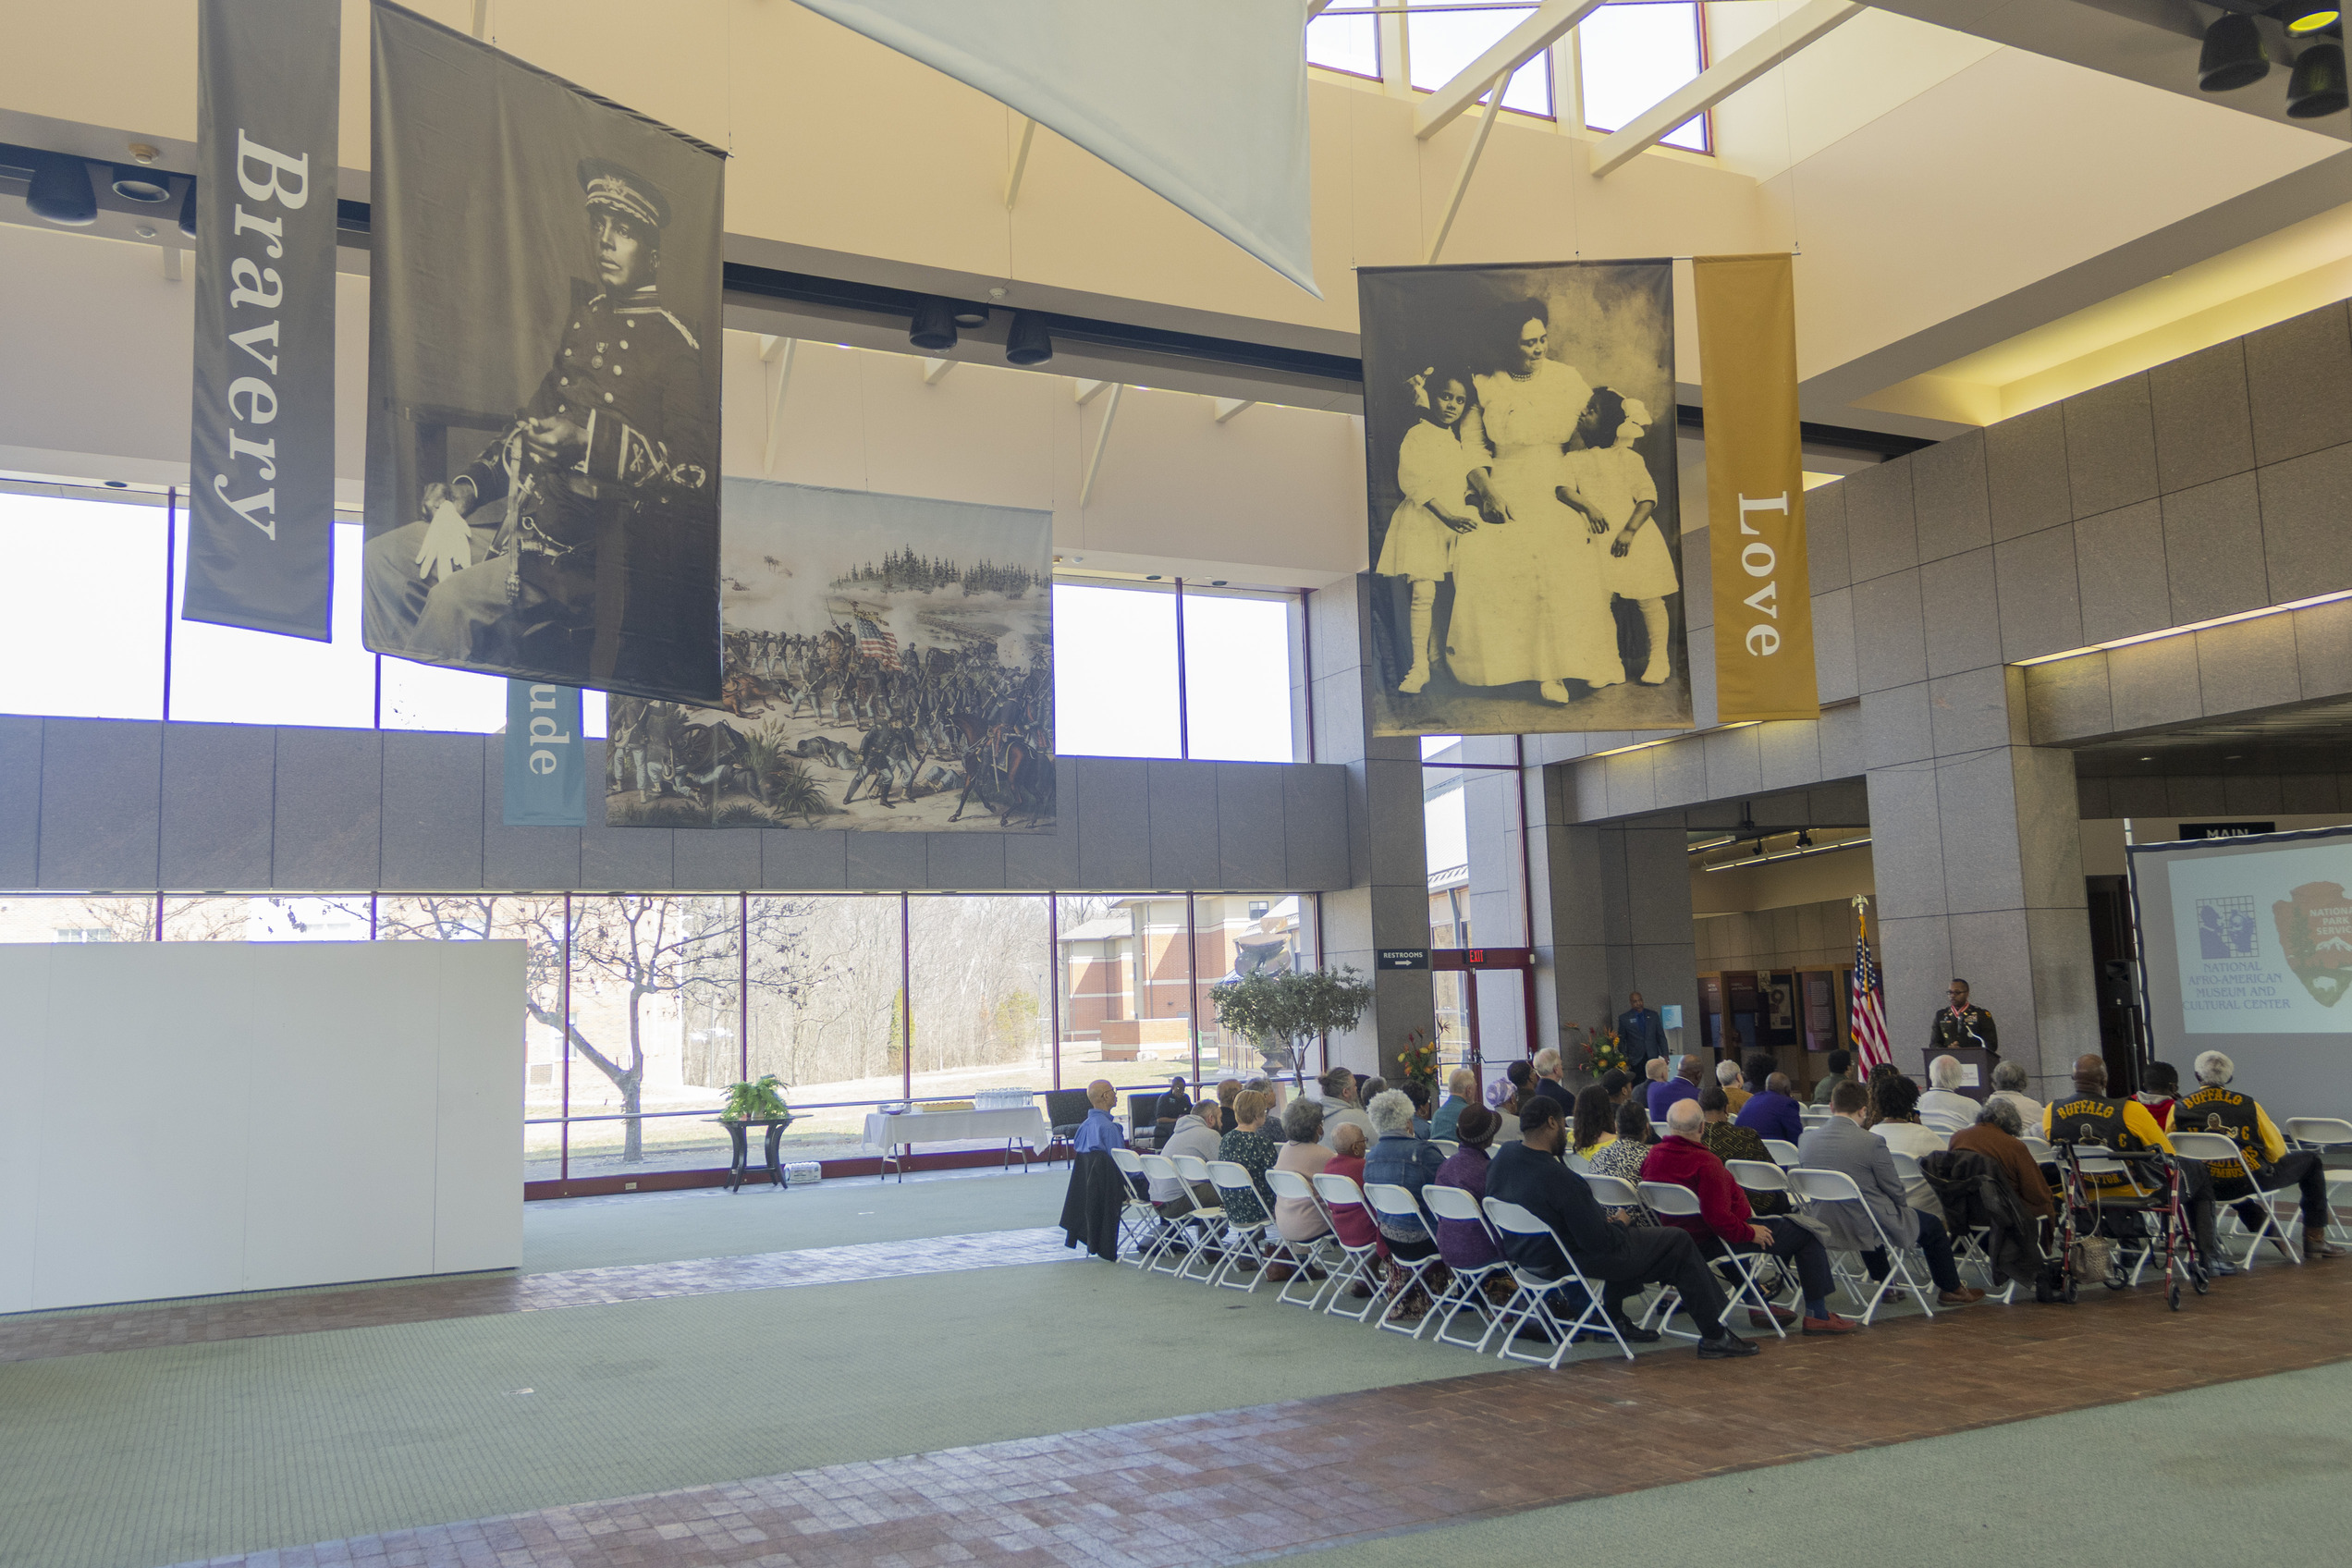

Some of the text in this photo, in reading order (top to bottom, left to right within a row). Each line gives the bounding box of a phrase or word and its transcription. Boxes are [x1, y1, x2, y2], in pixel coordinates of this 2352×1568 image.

[214, 128, 309, 541] Bravery
[1738, 491, 1789, 656] Love
[2206, 828, 2248, 839] MAIN
[2322, 916, 2350, 925] PARK
[1469, 949, 1484, 962] EXIT
[2203, 961, 2262, 972] NATIONAL
[2187, 973, 2283, 986] AFRO-AMERICAN
[2196, 986, 2276, 998] MUSEUM AND
[2183, 998, 2291, 1011] CULTURAL CENTER
[2183, 1088, 2243, 1109] BUFFALO
[2056, 1099, 2114, 1120] BUFFALO
[2241, 1126, 2249, 1140] C
